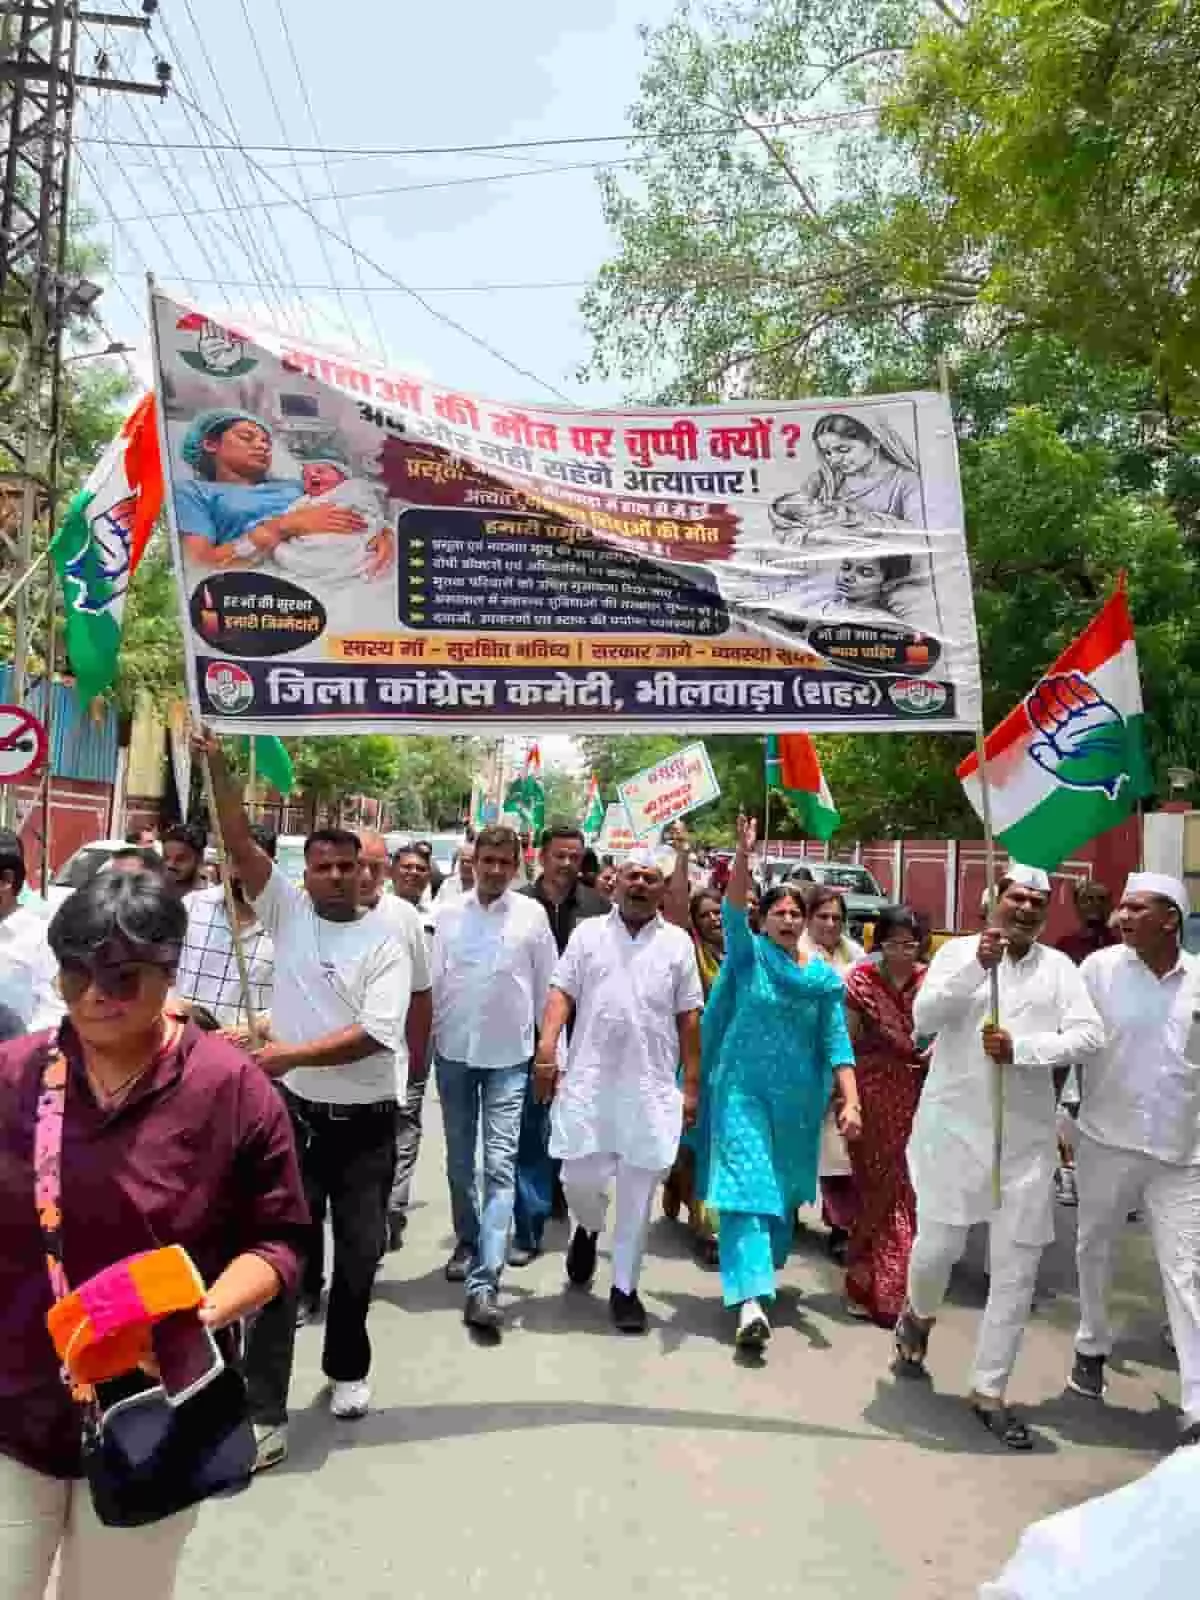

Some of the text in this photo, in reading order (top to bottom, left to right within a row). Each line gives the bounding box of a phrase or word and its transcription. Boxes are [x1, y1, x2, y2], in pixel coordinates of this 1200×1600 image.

[432, 390, 480, 432] की
[489, 406, 558, 452] मौत
[569, 426, 616, 457] पर
[624, 419, 698, 468] चुप्पी
[543, 457, 613, 489] सहेंगे
[447, 637, 512, 663] सुरक्षित
[516, 638, 570, 658] भविष्य
[592, 643, 652, 659] सरकार
[267, 667, 368, 706] जिला
[376, 671, 495, 709] कांग्रेस
[636, 672, 785, 711] भीलवाड़ा
[793, 676, 883, 708] (शहर)
